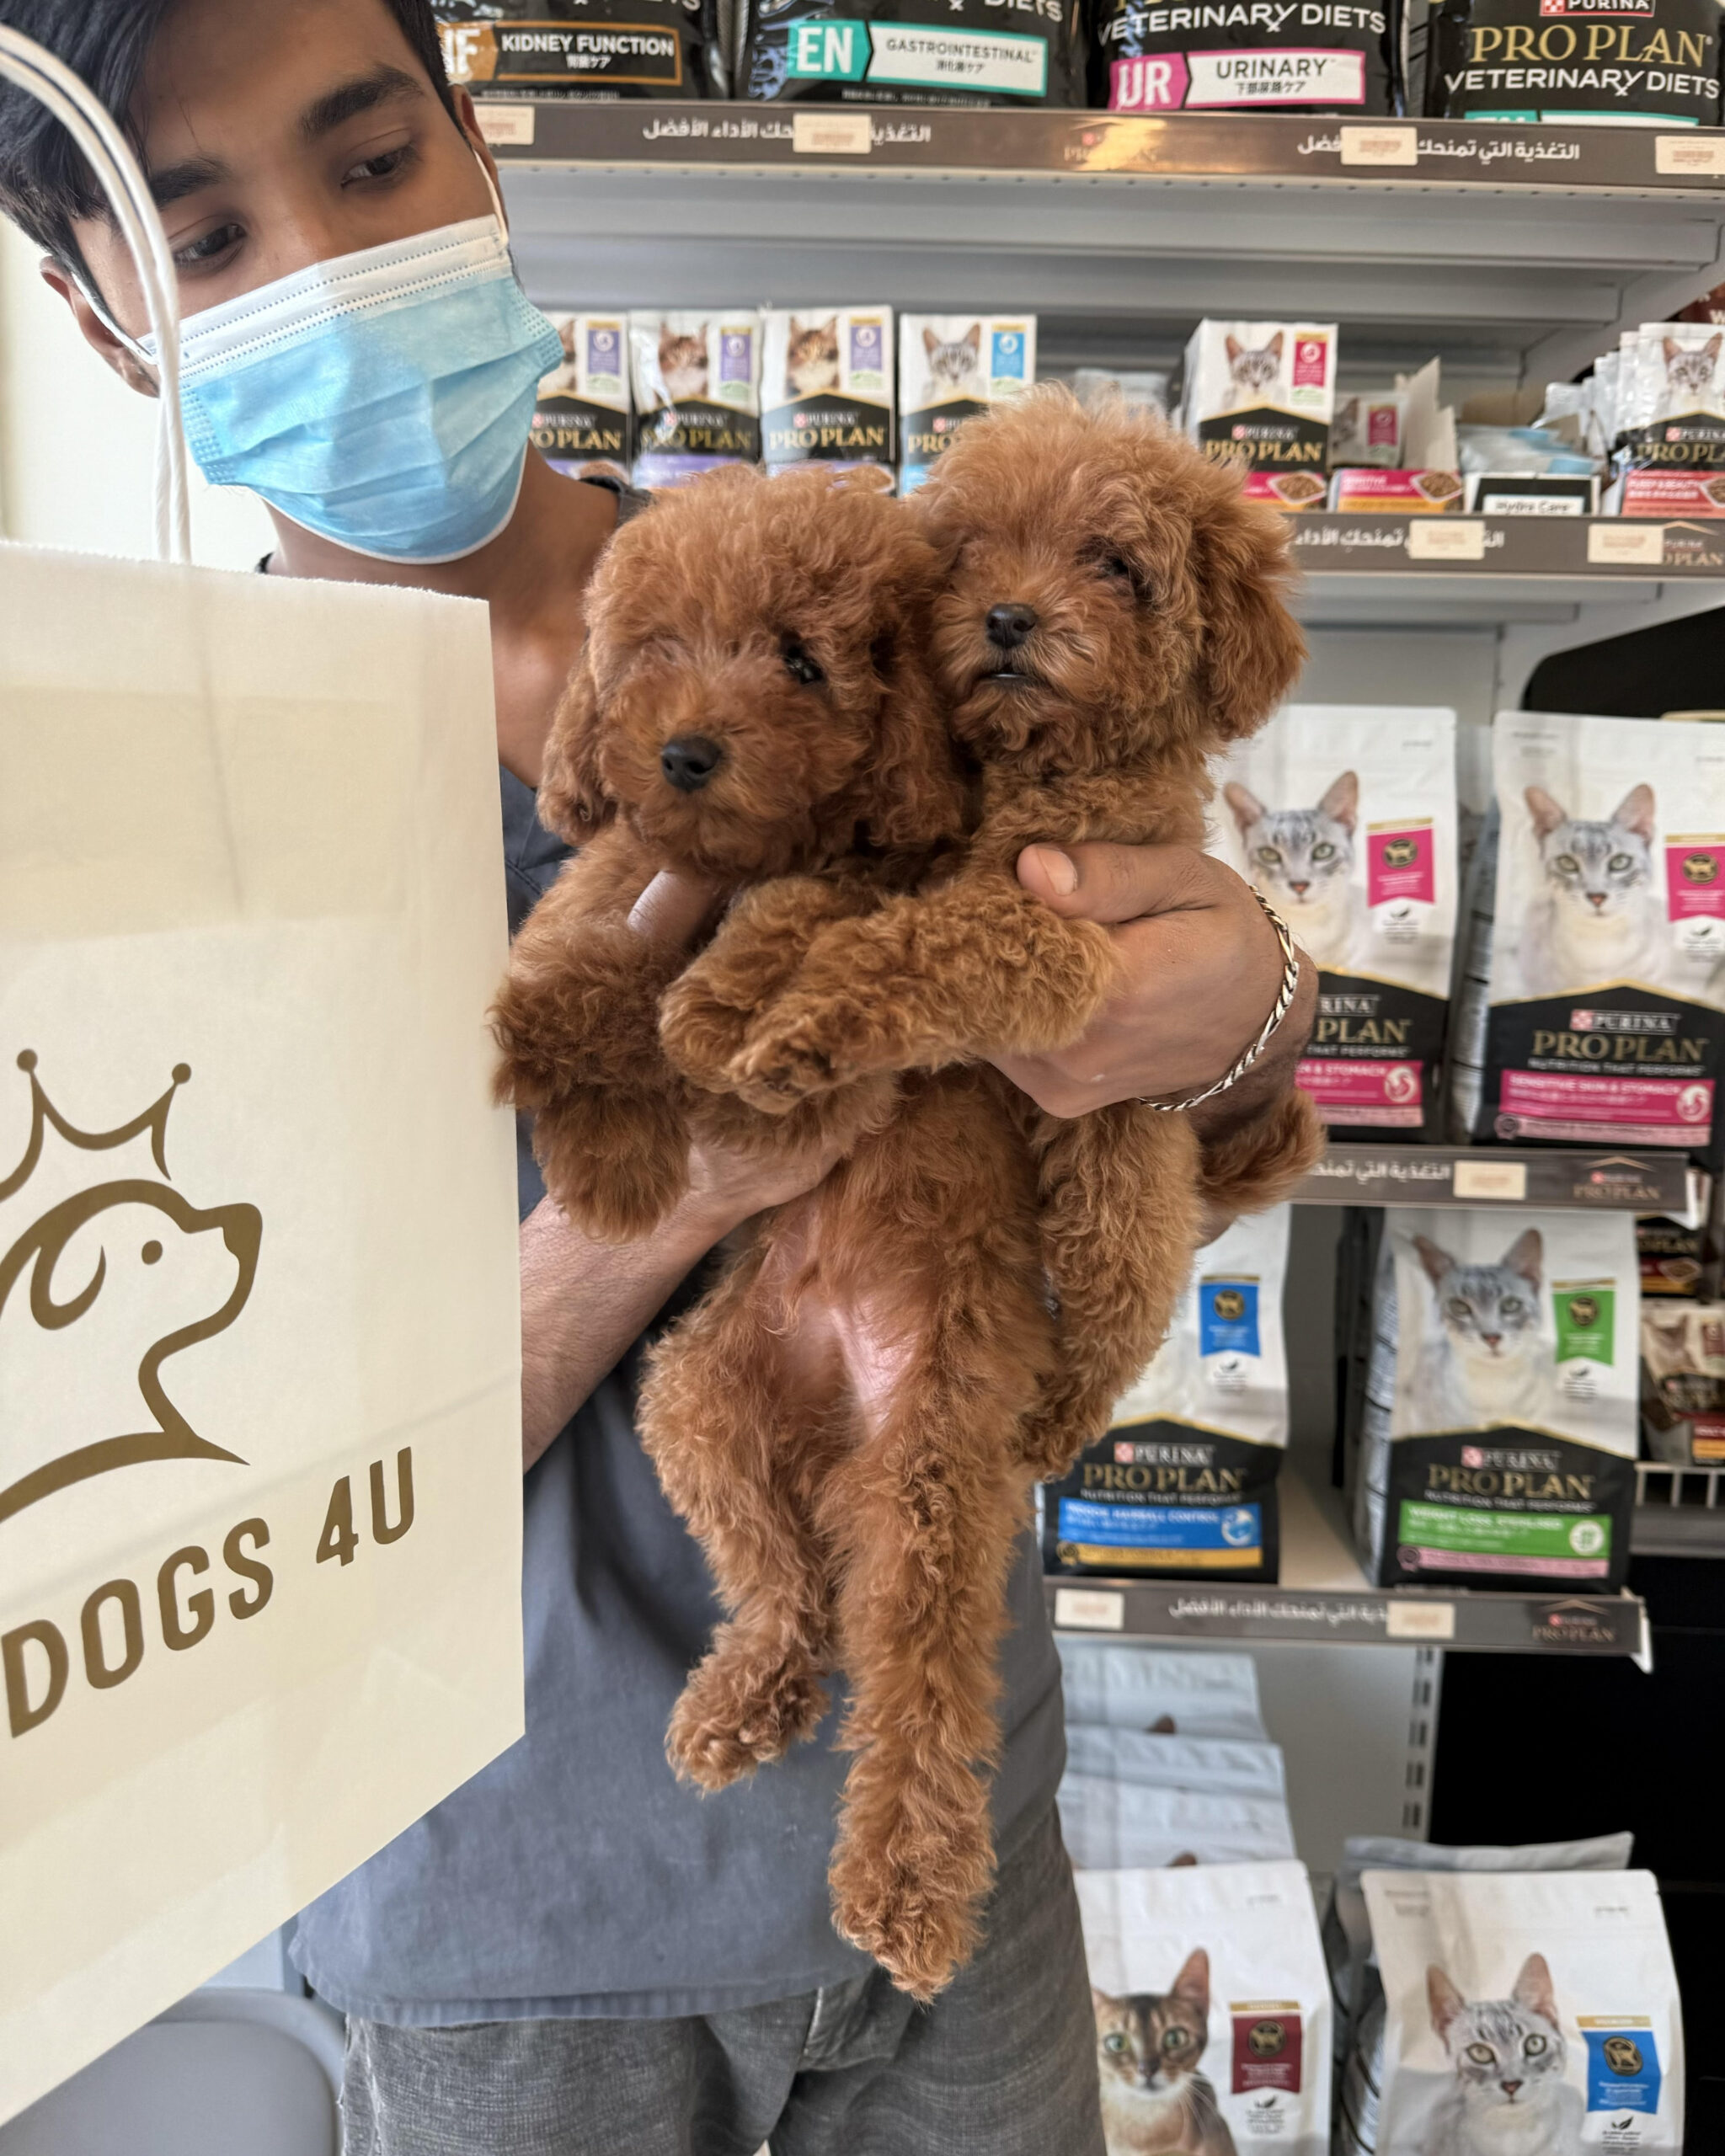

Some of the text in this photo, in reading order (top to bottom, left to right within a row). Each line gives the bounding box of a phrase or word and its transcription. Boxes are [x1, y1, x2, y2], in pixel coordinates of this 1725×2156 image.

[1097, 2, 1386, 46] VETERINARY DIETS
[501, 34, 674, 57] KIDNEY FUNCTION
[797, 26, 852, 73] EN
[886, 38, 1033, 64] GASTROINTESTINAL
[1469, 24, 1708, 68] PRO PLAN
[1216, 58, 1327, 79] URINARY
[1119, 61, 1172, 107] UR
[1444, 68, 1720, 99] VETERINARY DIETS
[642, 116, 708, 140] الأفضل
[710, 117, 759, 139] الأداء
[1417, 139, 1477, 157] تمنحك
[1478, 140, 1513, 165] التي
[1514, 141, 1580, 163] التغذية
[557, 428, 622, 451] PLAN
[688, 429, 752, 451] PLAN
[769, 425, 884, 450] PRO PLAN
[1206, 440, 1323, 462] PRO PLAN
[1316, 1017, 1408, 1043] PLAN
[1531, 1029, 1705, 1063] PRO PLAN
[1083, 1463, 1243, 1492] PRO PLAN
[1429, 1463, 1594, 1500] PRO PLAN
[1, 1446, 414, 1738] DOGS 4U
